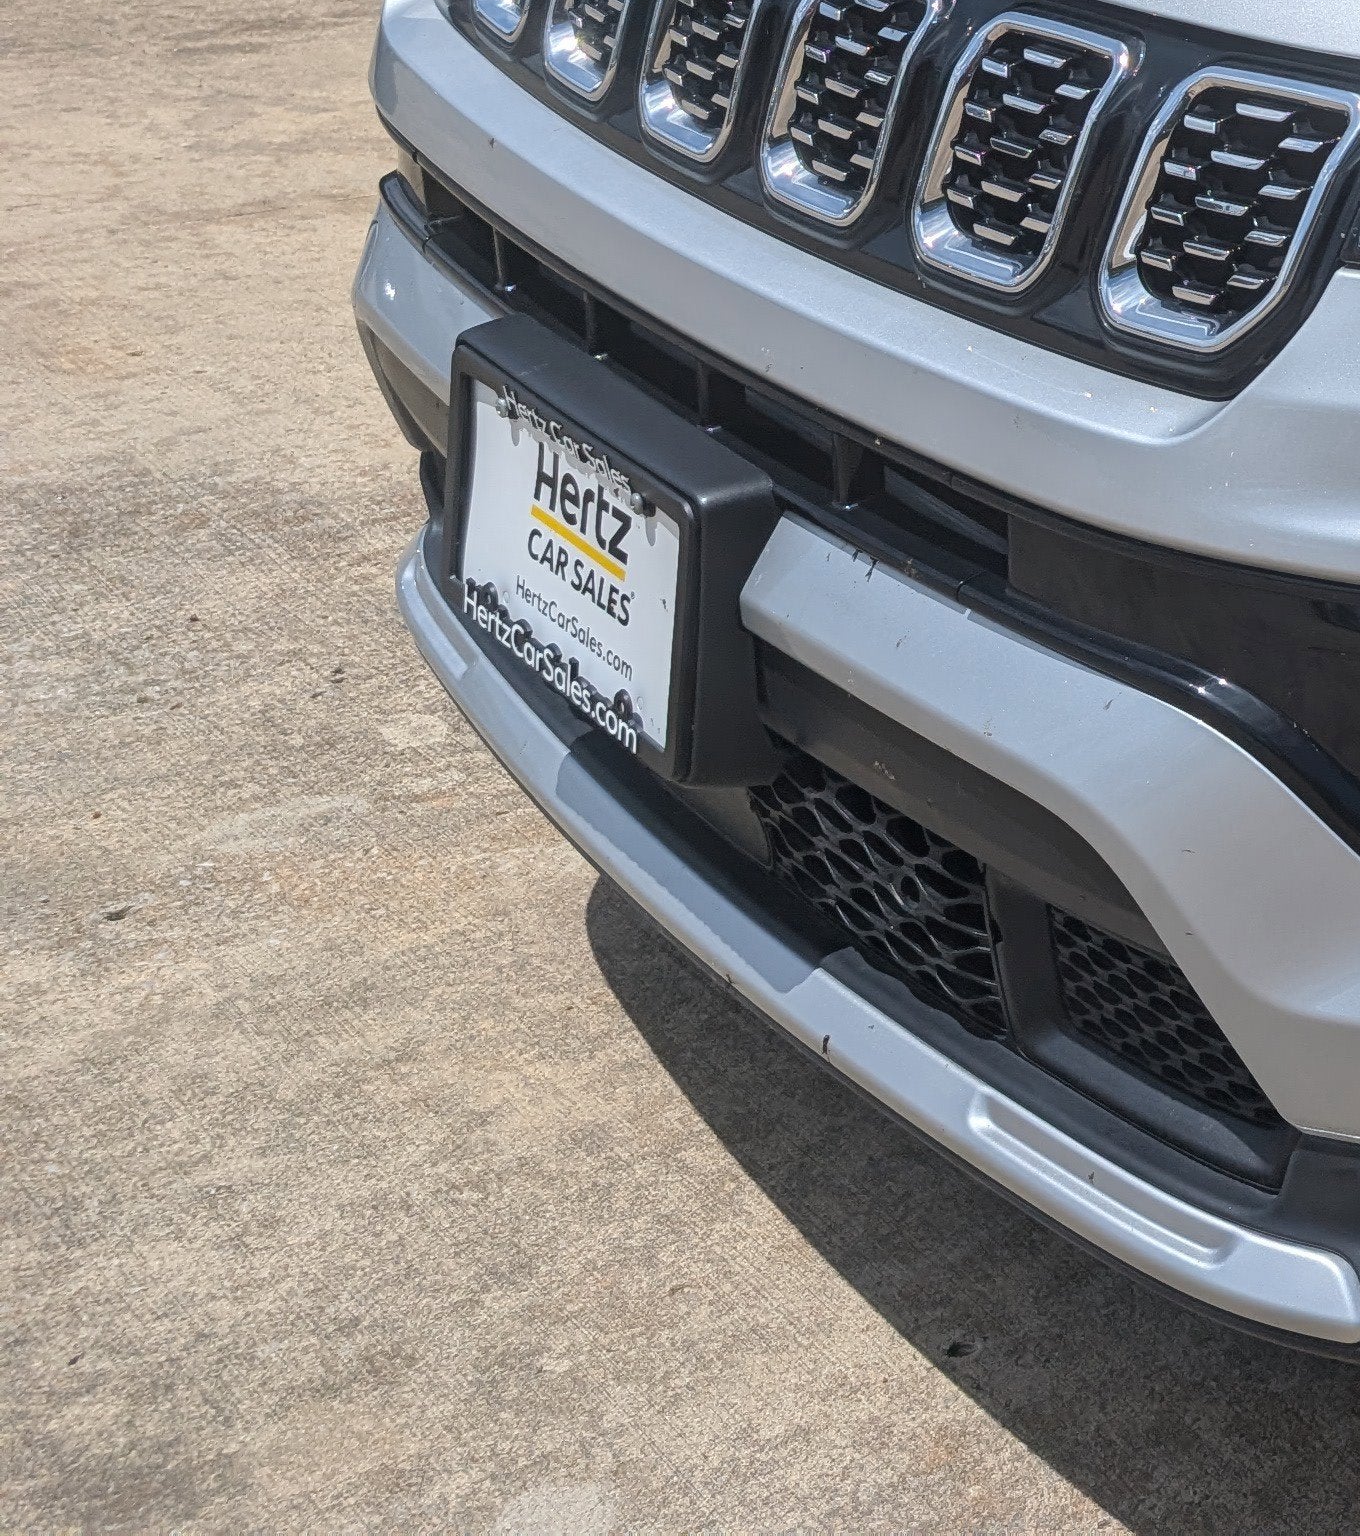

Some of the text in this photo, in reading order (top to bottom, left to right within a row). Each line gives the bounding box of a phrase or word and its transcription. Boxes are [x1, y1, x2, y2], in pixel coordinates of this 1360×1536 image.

[527, 528, 569, 582] CAR
[533, 442, 633, 566] Hertz
[463, 583, 638, 754] HertzCarSales.com
[516, 575, 633, 681] HertzCarSales.com
